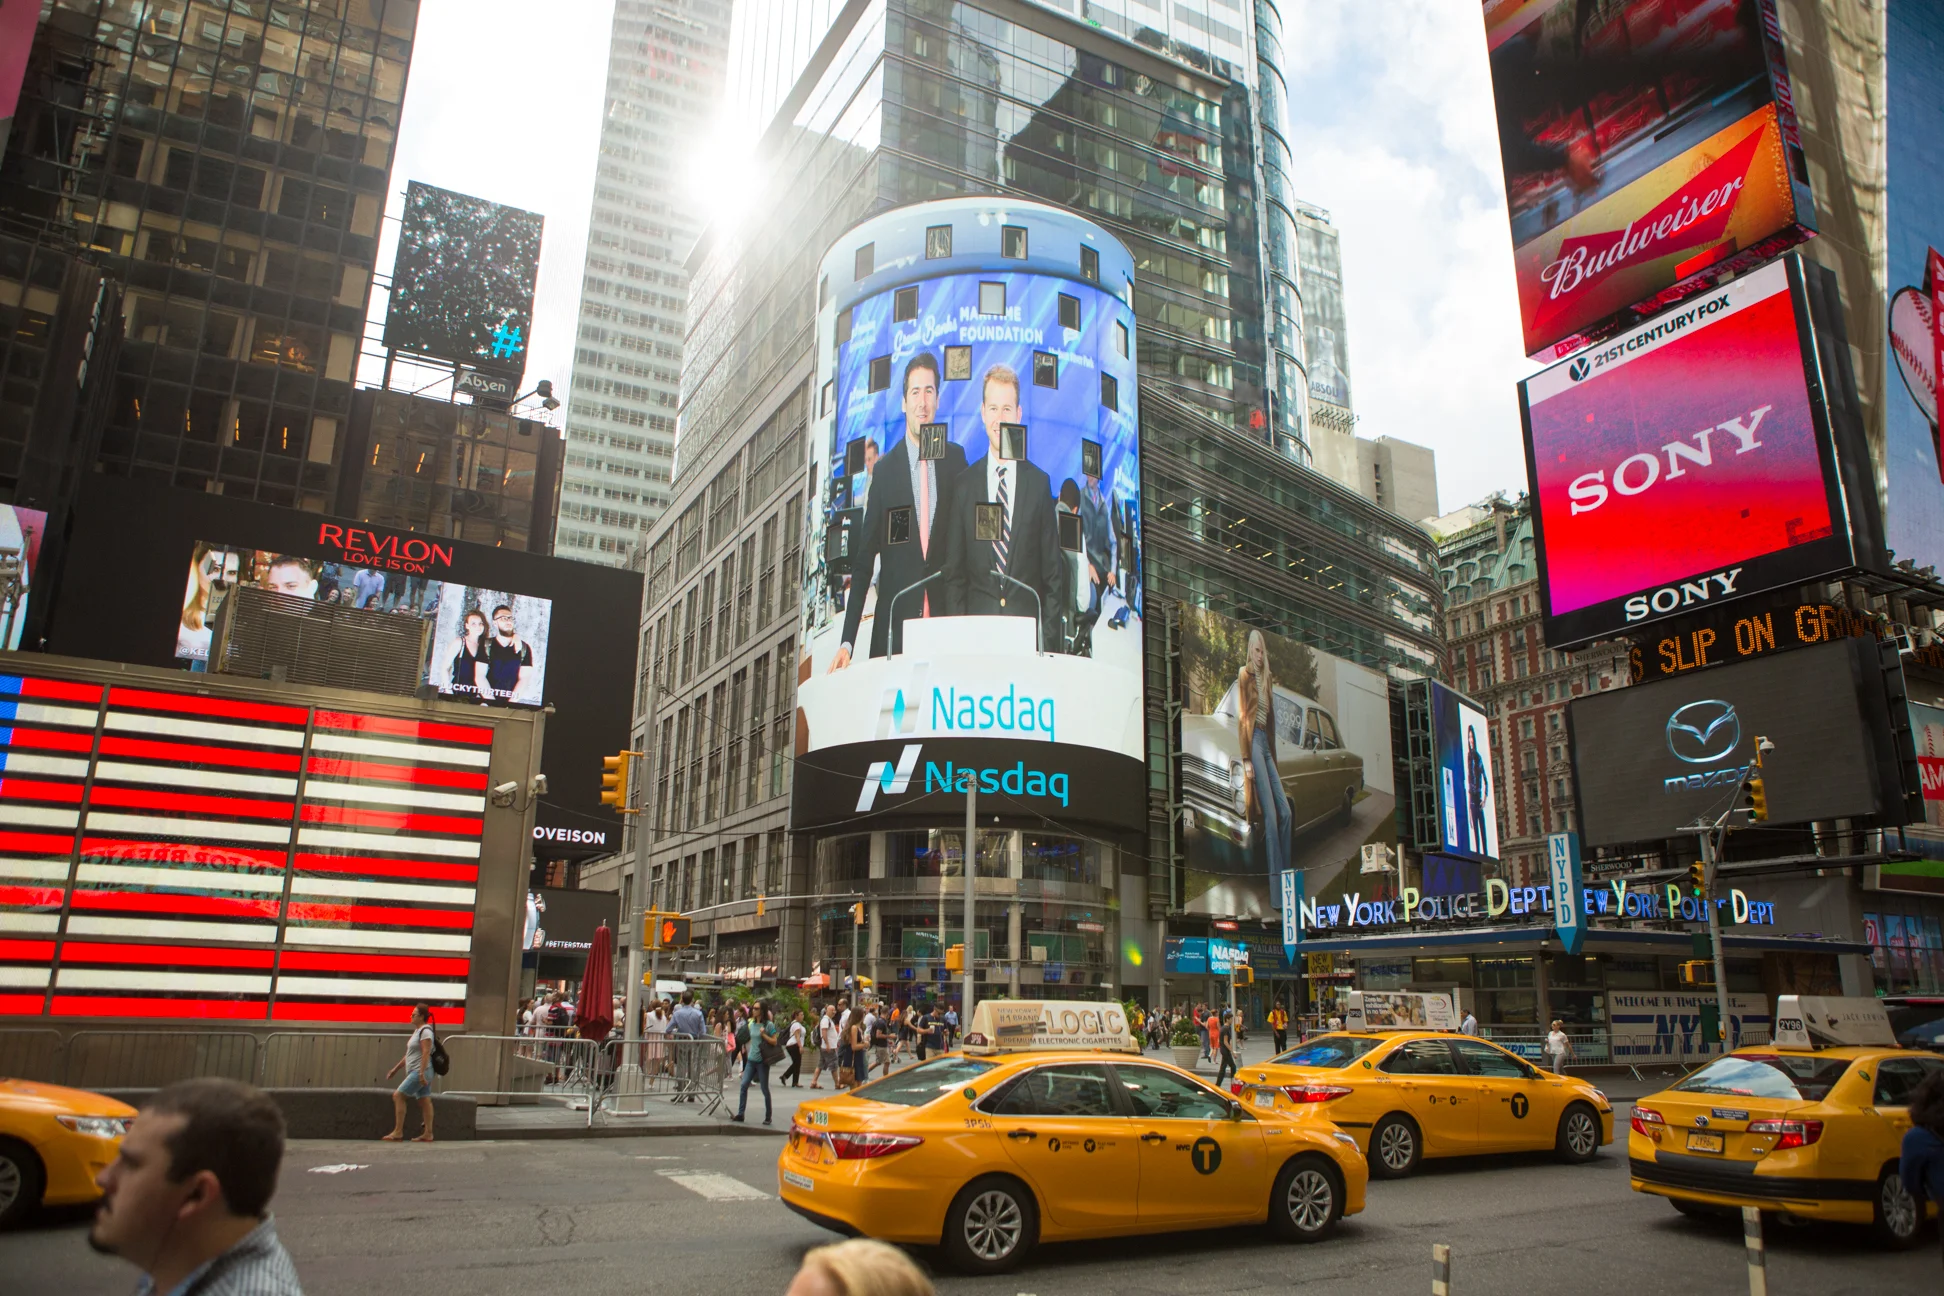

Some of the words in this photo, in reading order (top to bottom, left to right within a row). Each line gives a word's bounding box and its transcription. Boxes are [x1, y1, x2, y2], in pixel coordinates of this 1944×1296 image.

[1540, 174, 1745, 300] Budweiser
[959, 326, 1044, 345] FOUNDATION
[1593, 342, 1626, 369] 21ST
[1626, 307, 1697, 352] CENTURY
[1698, 293, 1731, 320] FOX
[455, 374, 506, 393] Absen
[1567, 404, 1773, 517] SONY
[318, 523, 453, 567] REVLON
[343, 551, 382, 568] LOVE
[386, 559, 400, 571] IS
[403, 562, 425, 573] ON
[1624, 567, 1742, 622] SONY
[1574, 645, 1624, 663] SHERWOOD
[1657, 626, 1717, 674] SLIP
[1734, 612, 1776, 657] ON
[932, 683, 1056, 743] Nasdaq
[925, 760, 1069, 808] Nasdaq
[1590, 861, 1633, 873] SHERWOOD
[1553, 837, 1573, 925] NYPD
[1284, 872, 1295, 943] NYPD
[1300, 895, 1341, 930] NEW
[1343, 892, 1397, 927] YORK
[1404, 887, 1479, 923] POLICE
[1486, 878, 1550, 917] DEPT
[1583, 887, 1609, 916] EW
[1610, 879, 1662, 919] YORK
[1729, 888, 1775, 925] DEPT
[545, 940, 592, 949] #BETTERSTART
[1211, 944, 1249, 964] NASDAQ
[1252, 943, 1284, 955] VAILABLE
[1614, 996, 1659, 1007] WELCOME
[1663, 996, 1673, 1007] TO
[1013, 1014, 1040, 1022] BRAND
[1780, 1020, 1802, 1030] 2Y96
[1842, 1013, 1858, 1021] JACK
[1003, 1037, 1037, 1045] PREMIUM
[1038, 1037, 1081, 1045] ELECTRONIC
[1081, 1037, 1122, 1045] CIGARETTES
[1652, 1014, 1741, 1054] NYD
[1514, 1097, 1525, 1117] T
[1198, 1143, 1215, 1171] T
